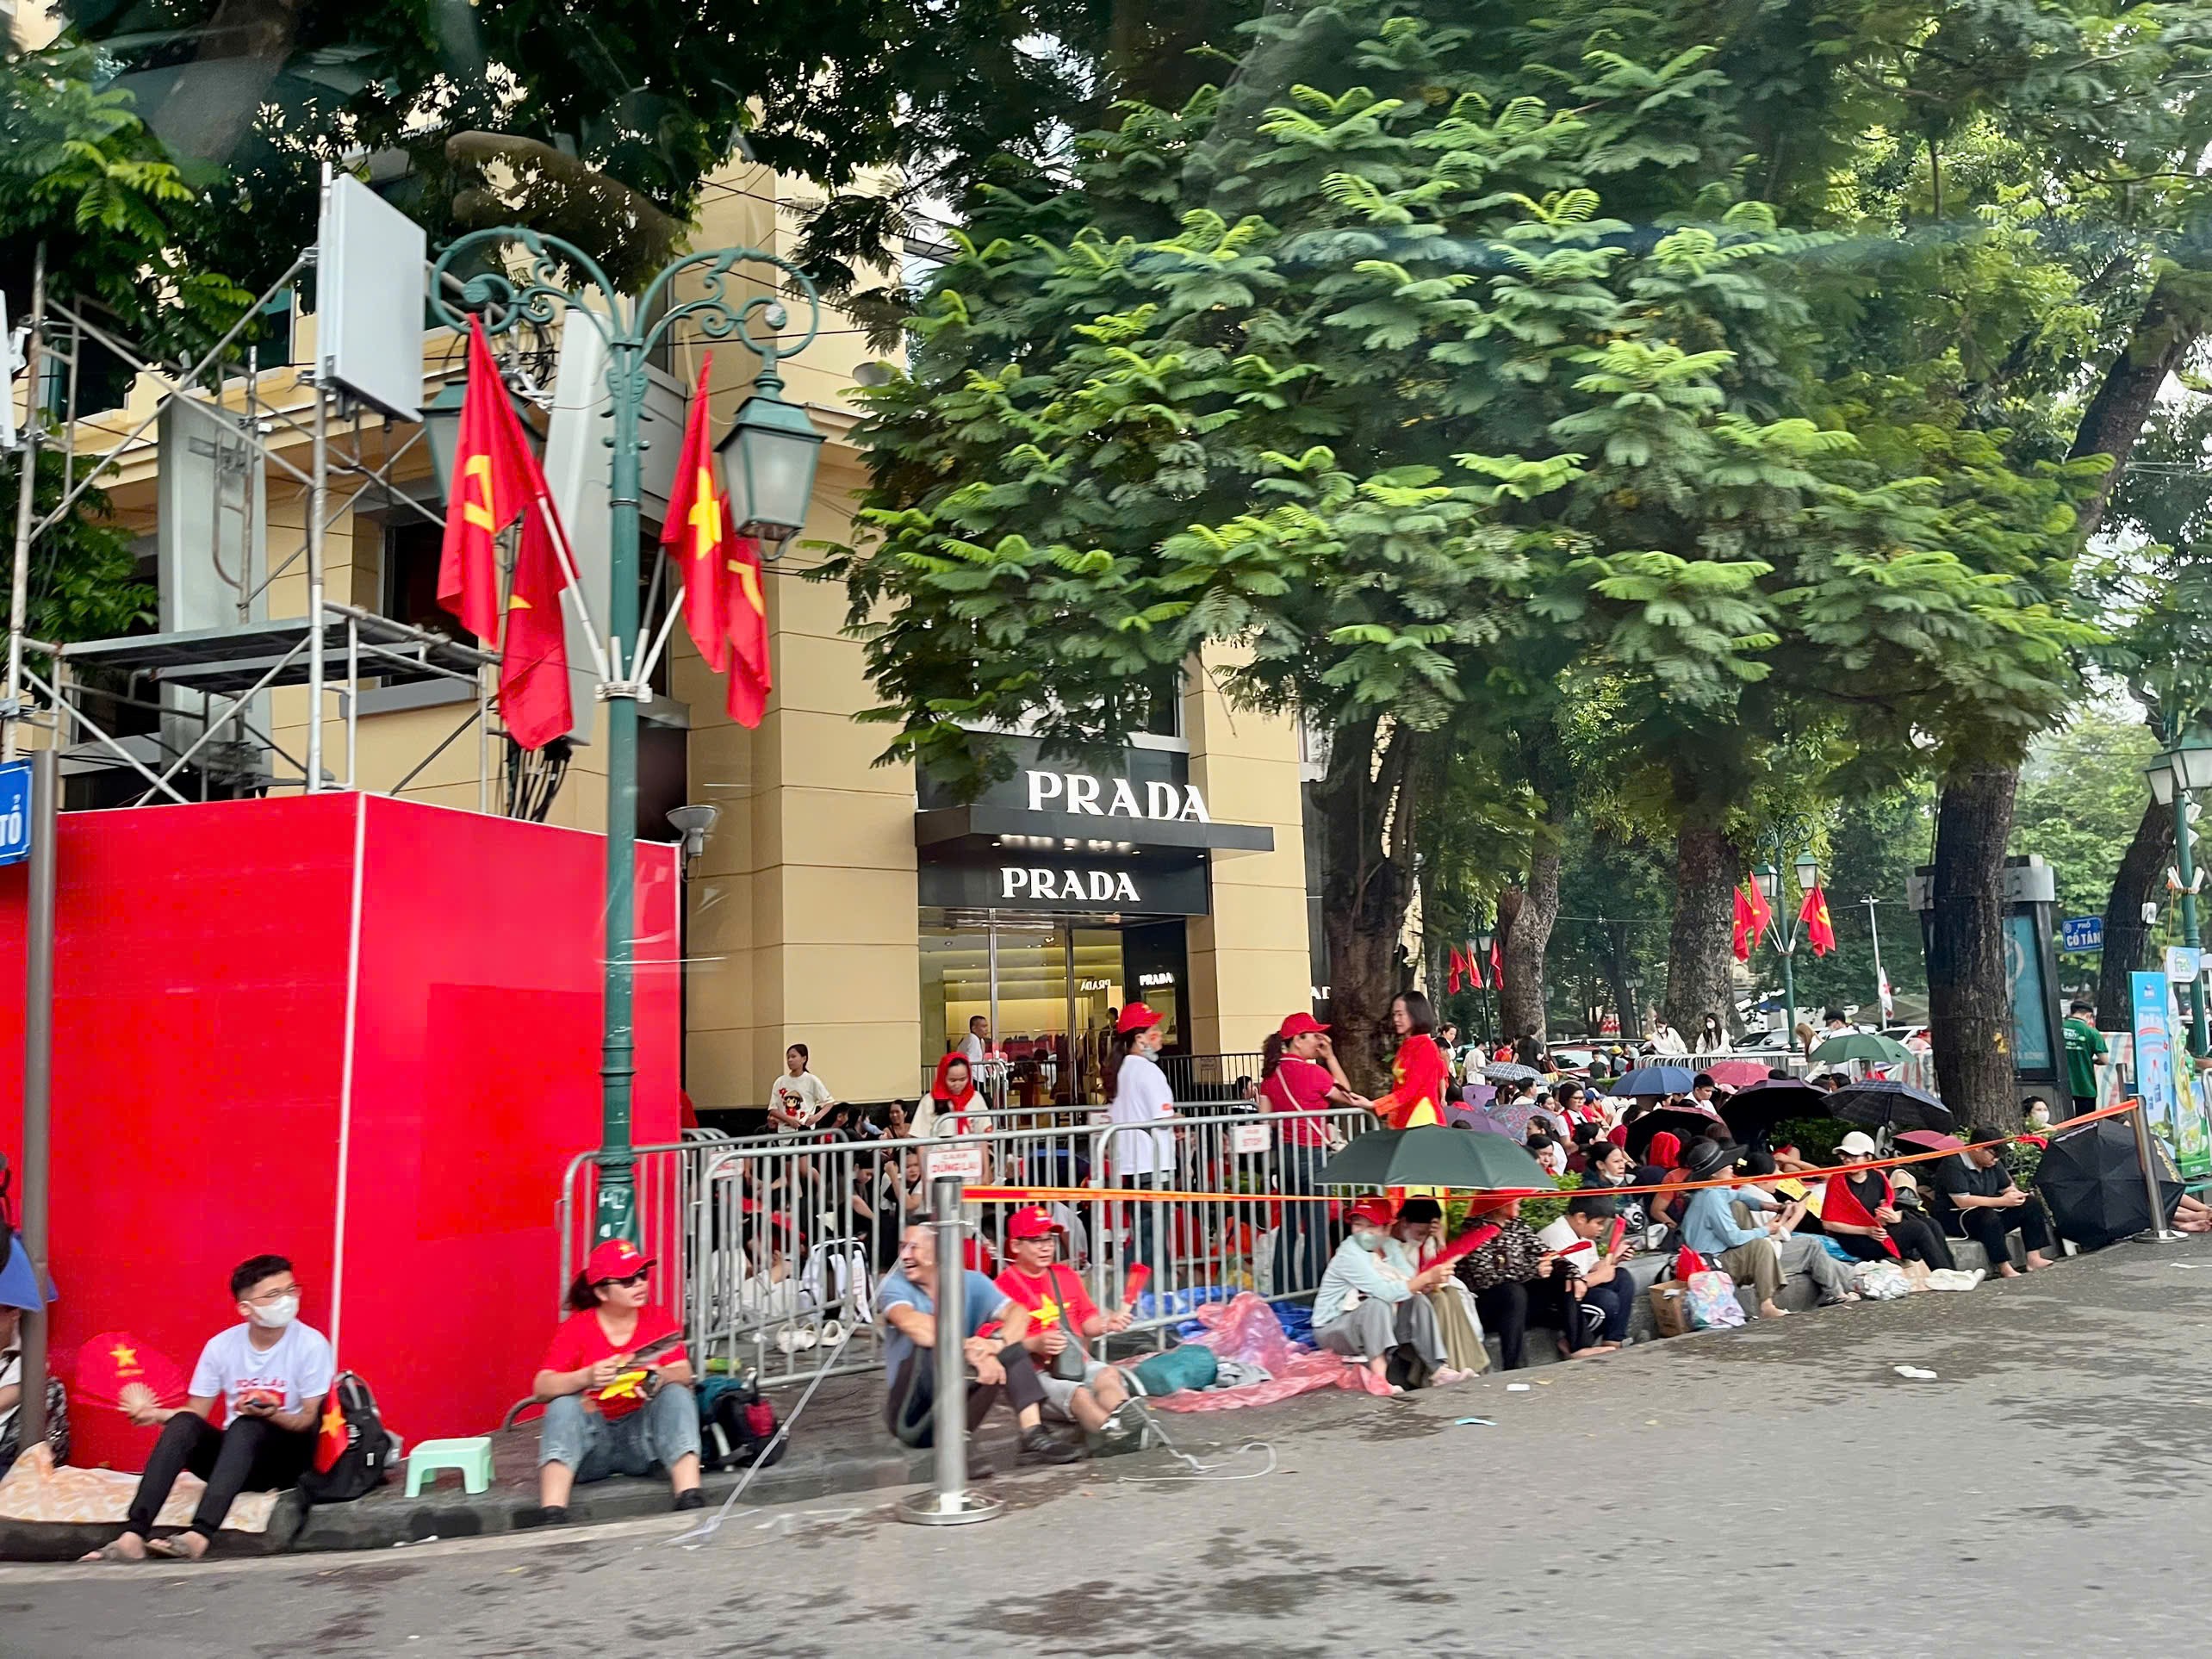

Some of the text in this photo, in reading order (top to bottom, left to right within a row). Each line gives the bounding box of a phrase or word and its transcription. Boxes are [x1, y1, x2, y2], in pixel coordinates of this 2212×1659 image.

[1025, 770, 1210, 823] PRADA
[1000, 867, 1141, 902] PRADA
[1139, 972, 1175, 986] PRADA
